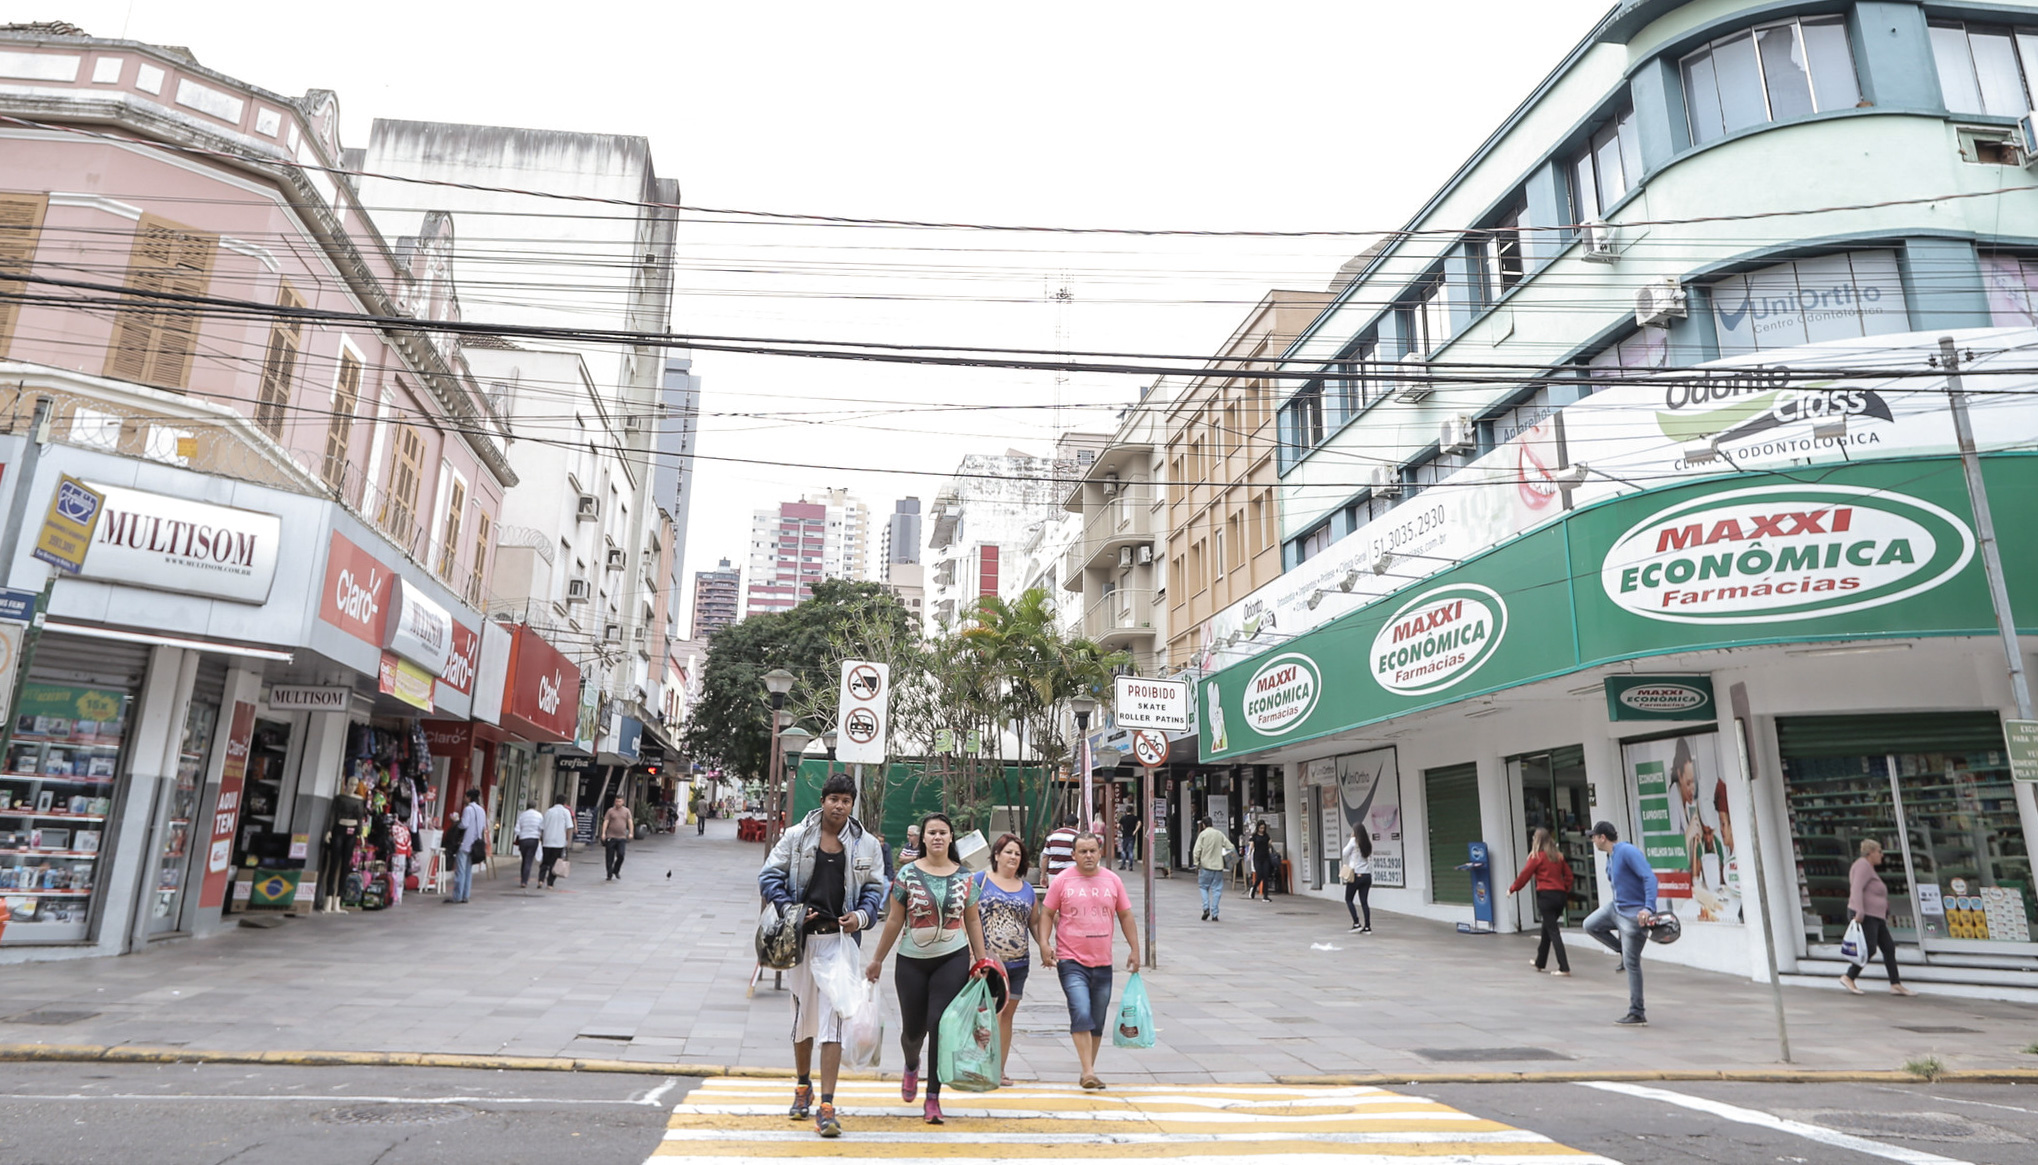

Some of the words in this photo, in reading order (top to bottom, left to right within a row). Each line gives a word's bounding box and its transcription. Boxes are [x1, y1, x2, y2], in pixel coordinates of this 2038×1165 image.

[1750, 283, 1881, 320] UniOrtho
[1754, 318, 1794, 334] Centro
[1666, 364, 1791, 410] Odonto
[98, 508, 258, 568] MULTISOM
[1655, 507, 1853, 553] MAXXI
[165, 557, 252, 576] WWW.MULTISOM.COM.BR
[1620, 538, 1916, 594] ECONÔMICA
[336, 568, 376, 624] Claro
[1662, 575, 1861, 608] Farmácias
[1392, 600, 1463, 644] MAXXI
[1379, 620, 1485, 674] ECONÔMICA
[1256, 666, 1297, 693] MAXXI
[1395, 653, 1465, 683] Farmácias
[273, 690, 343, 706] MULTISOM
[538, 671, 560, 716] Claro
[1128, 685, 1175, 699] PROIBIDO
[1248, 682, 1310, 716] ECONÔMICA
[1120, 713, 1150, 721] ROLLER
[1156, 716, 1185, 724] PATINS
[1138, 703, 1166, 711] SKATE
[1257, 706, 1299, 724] Farmácias
[426, 729, 465, 745] Claro
[560, 757, 590, 769] crefisa
[218, 791, 238, 811] AQUI
[215, 812, 235, 834] TEM
[1067, 888, 1112, 897] PARA
